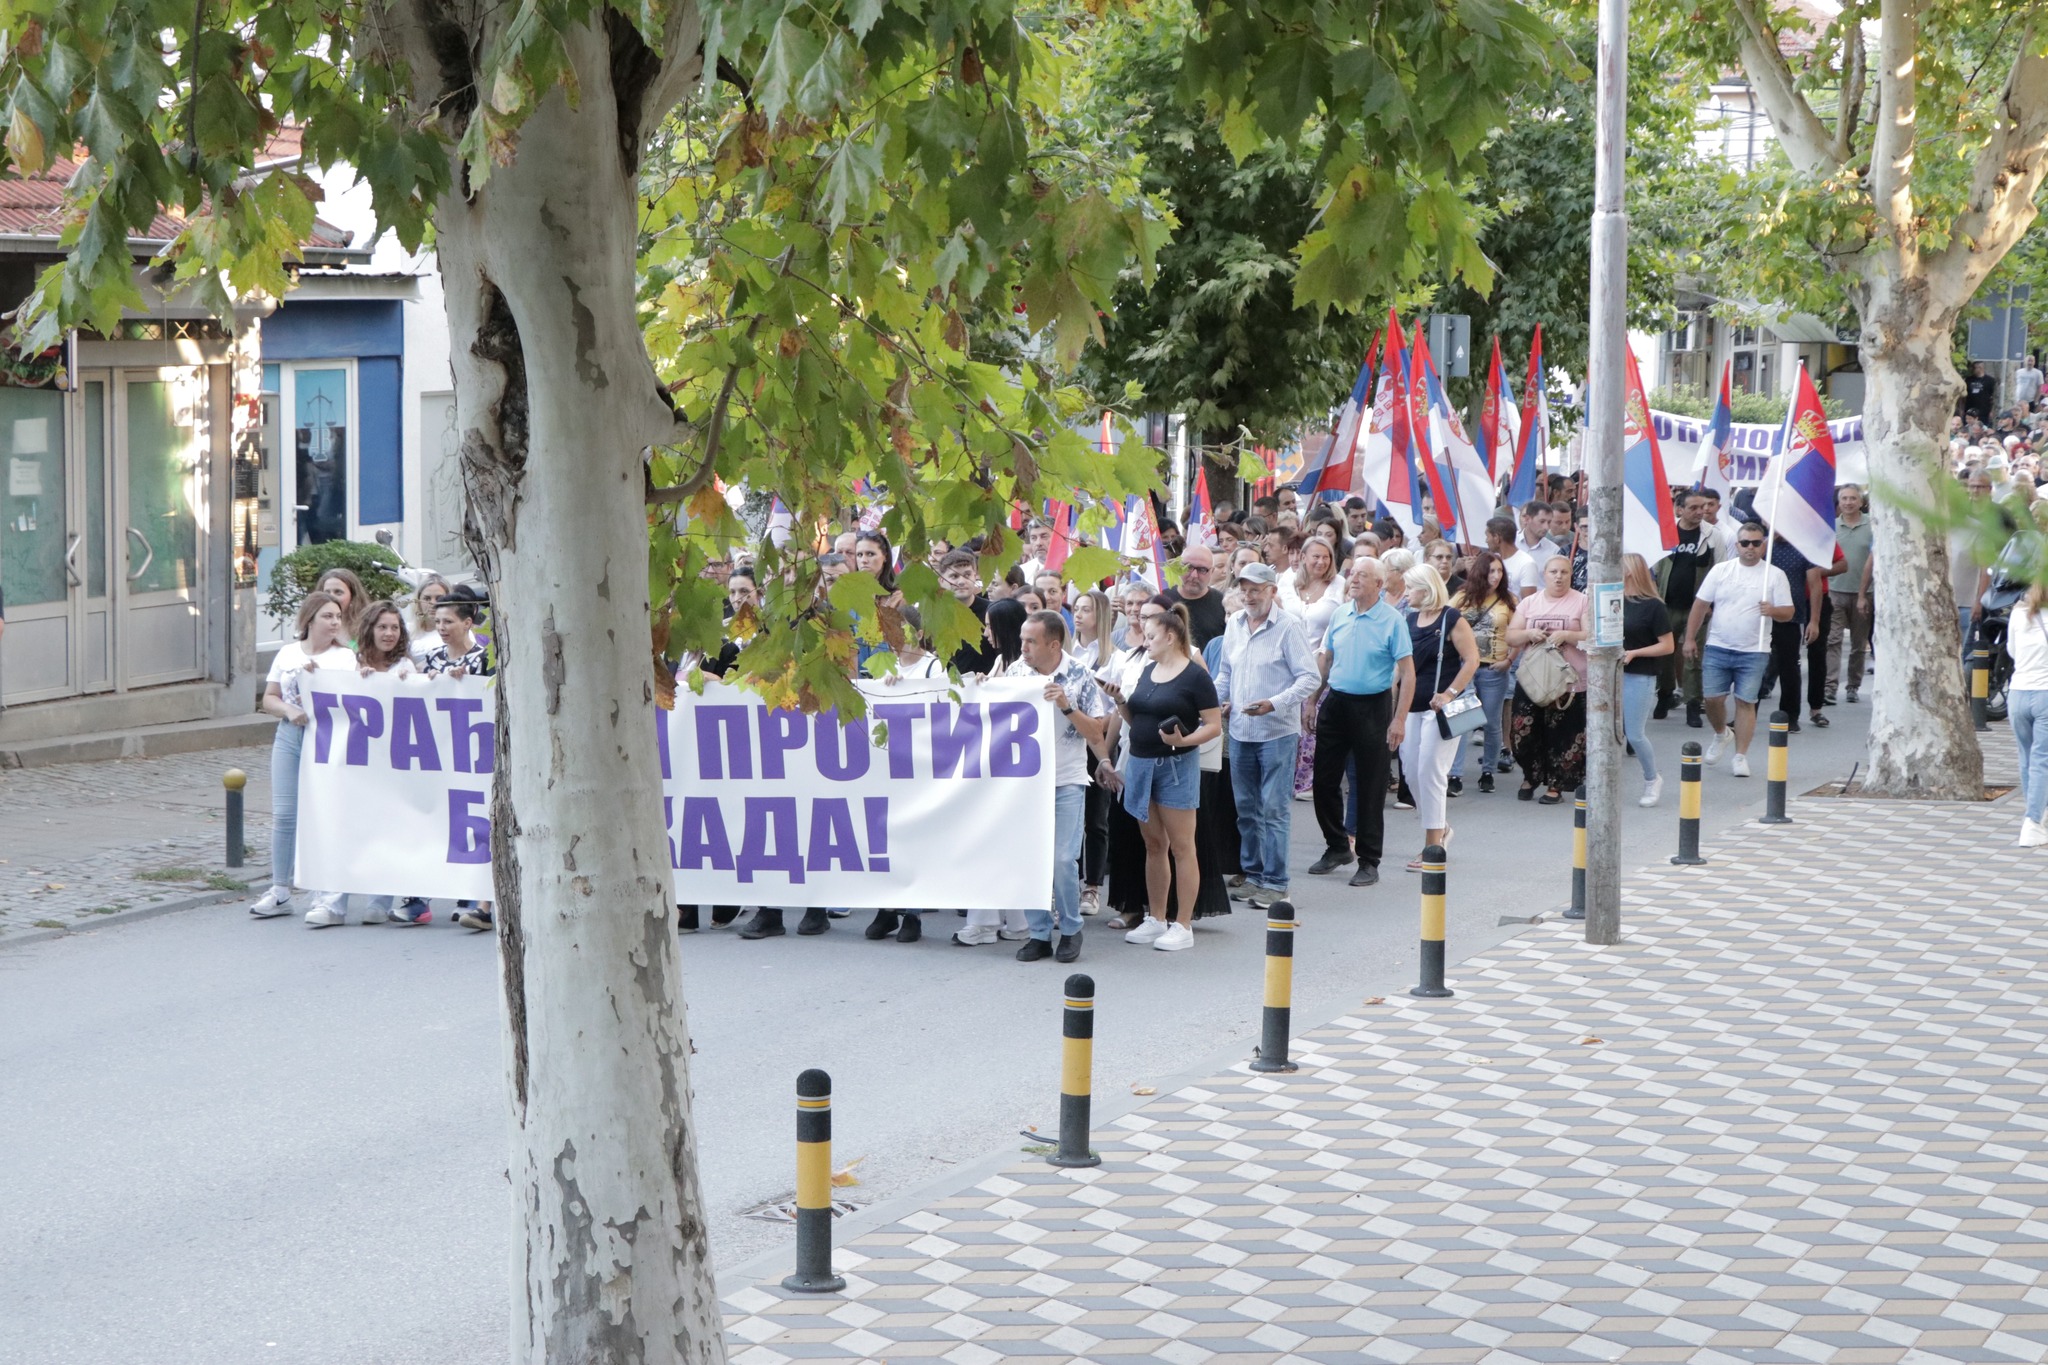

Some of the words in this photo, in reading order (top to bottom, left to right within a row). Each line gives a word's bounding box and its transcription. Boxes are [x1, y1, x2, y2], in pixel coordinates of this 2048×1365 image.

[311, 691, 672, 780] ГРАЂ
[695, 701, 1042, 782] ПРОТИВ
[446, 788, 890, 885] БАДА!
